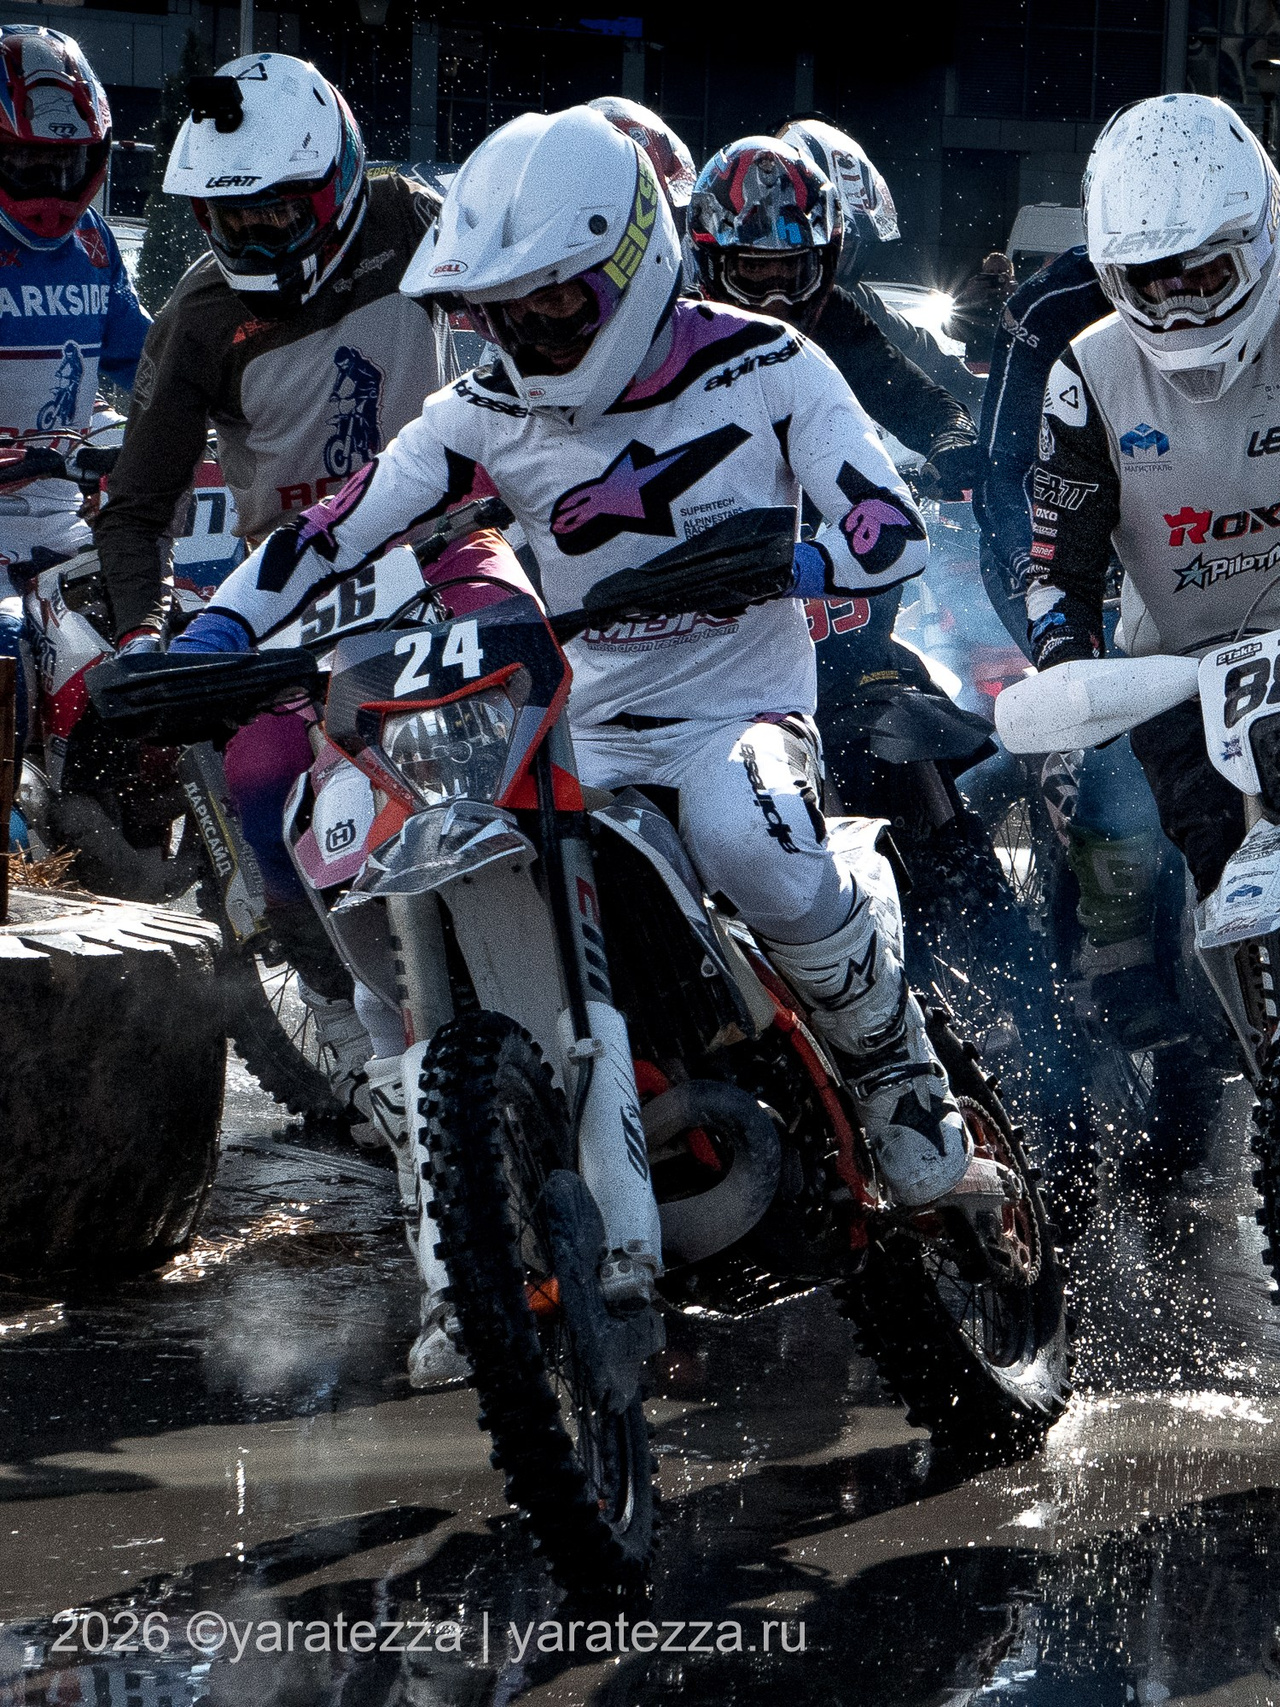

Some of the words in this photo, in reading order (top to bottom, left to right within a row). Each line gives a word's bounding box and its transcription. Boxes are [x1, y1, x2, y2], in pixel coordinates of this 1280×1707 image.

[205, 175, 262, 189] LEATT
[1101, 228, 1197, 258] LEATT
[434, 264, 461, 275] BELL
[680, 497, 735, 517] SUPERTECH
[393, 619, 484, 698] 24
[184, 781, 232, 877] ДАРКСАЙД
